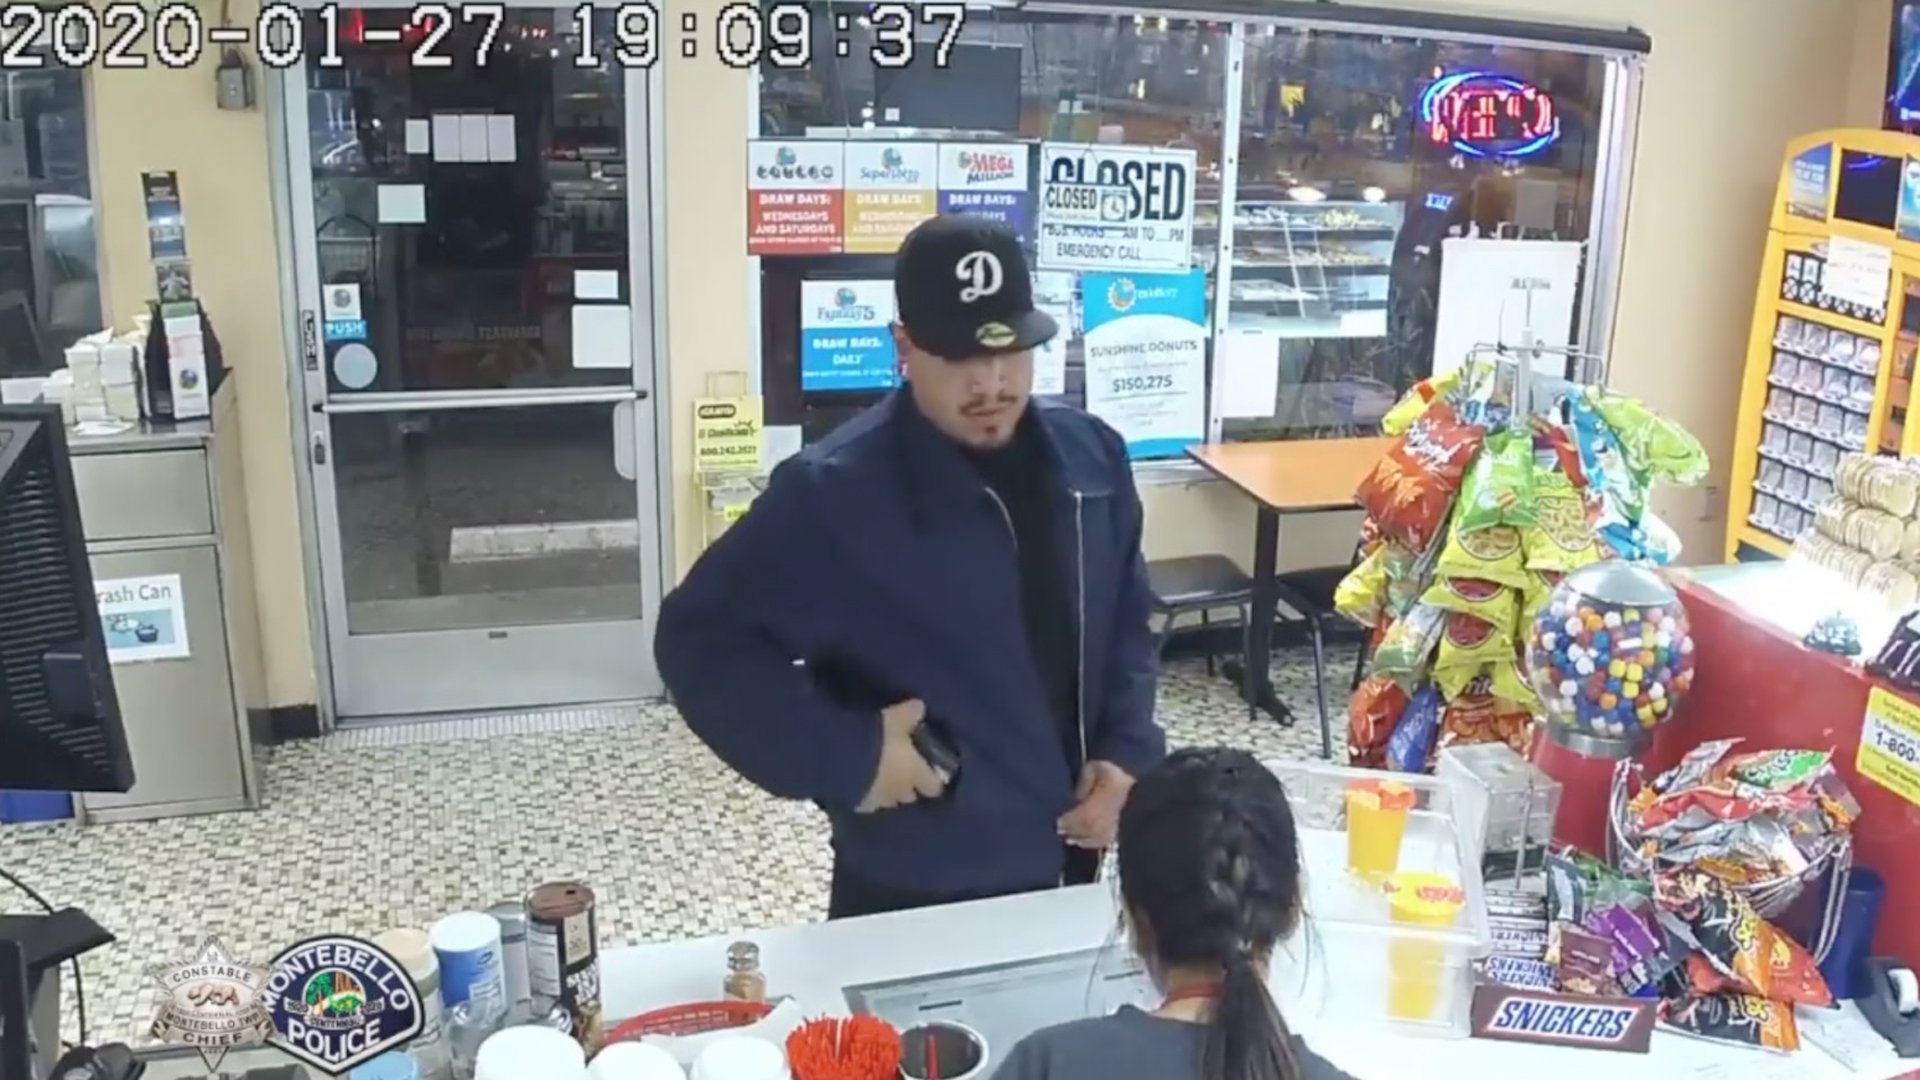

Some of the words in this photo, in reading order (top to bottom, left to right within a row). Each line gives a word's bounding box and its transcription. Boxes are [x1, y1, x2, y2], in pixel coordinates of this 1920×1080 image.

[972, 152, 1014, 172] MEGA
[759, 193, 794, 205] DRAW
[949, 193, 981, 205] DRAW
[1046, 186, 1097, 210] CLOSED
[762, 211, 829, 222] WEDNESDAYS
[1142, 228, 1155, 241] TO
[1169, 229, 1184, 242] PM
[1056, 243, 1115, 259] EMERGENCY
[1118, 246, 1141, 260] CALL
[955, 250, 1003, 302] D
[325, 321, 364, 335] PUSH
[812, 338, 848, 349] DRAW
[1090, 344, 1146, 358] SUNSHINE
[1148, 340, 1197, 352] DONUTS
[1112, 374, 1173, 393] $150,275
[96, 586, 134, 604] rash
[139, 584, 171, 600] Can
[1495, 1000, 1633, 1039] SNICKERS
